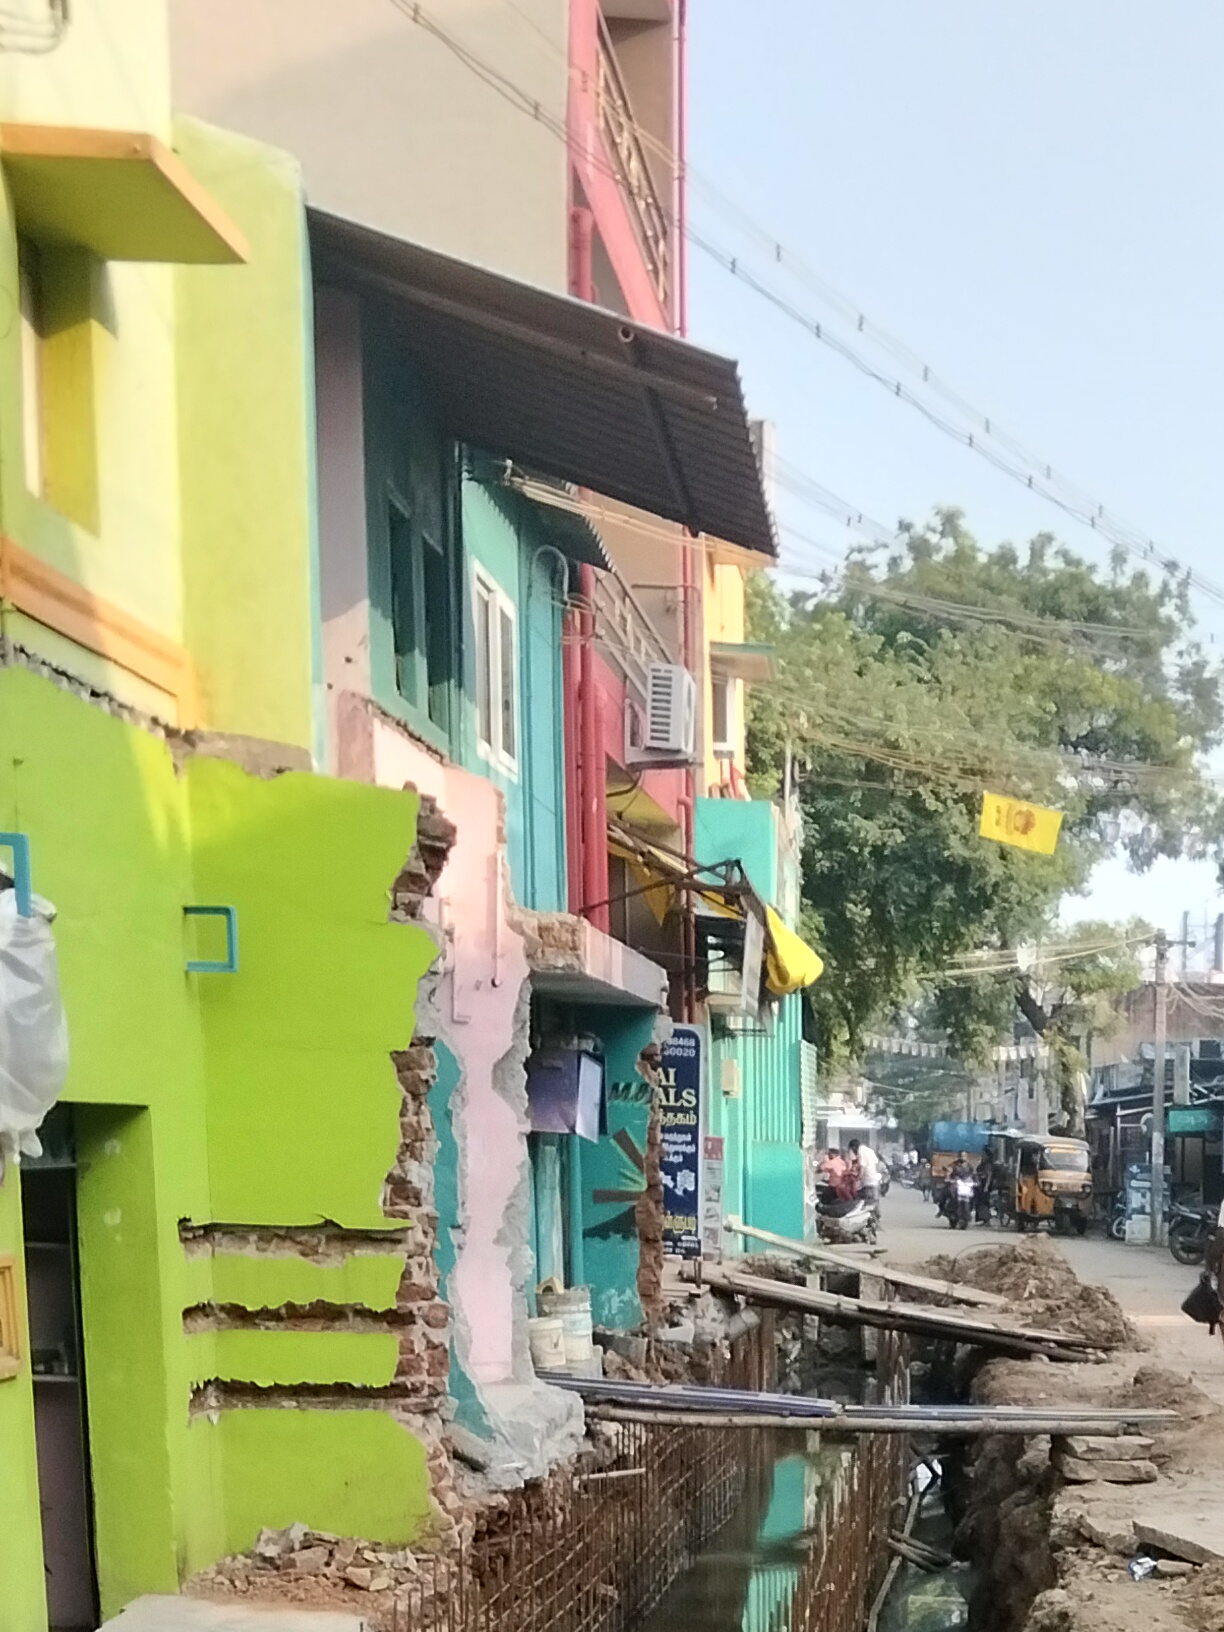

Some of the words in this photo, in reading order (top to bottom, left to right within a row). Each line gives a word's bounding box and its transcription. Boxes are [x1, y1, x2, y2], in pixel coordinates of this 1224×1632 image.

[668, 1036, 696, 1047] 8468
[656, 1066, 677, 1087] AI
[657, 1087, 698, 1108] ALS
